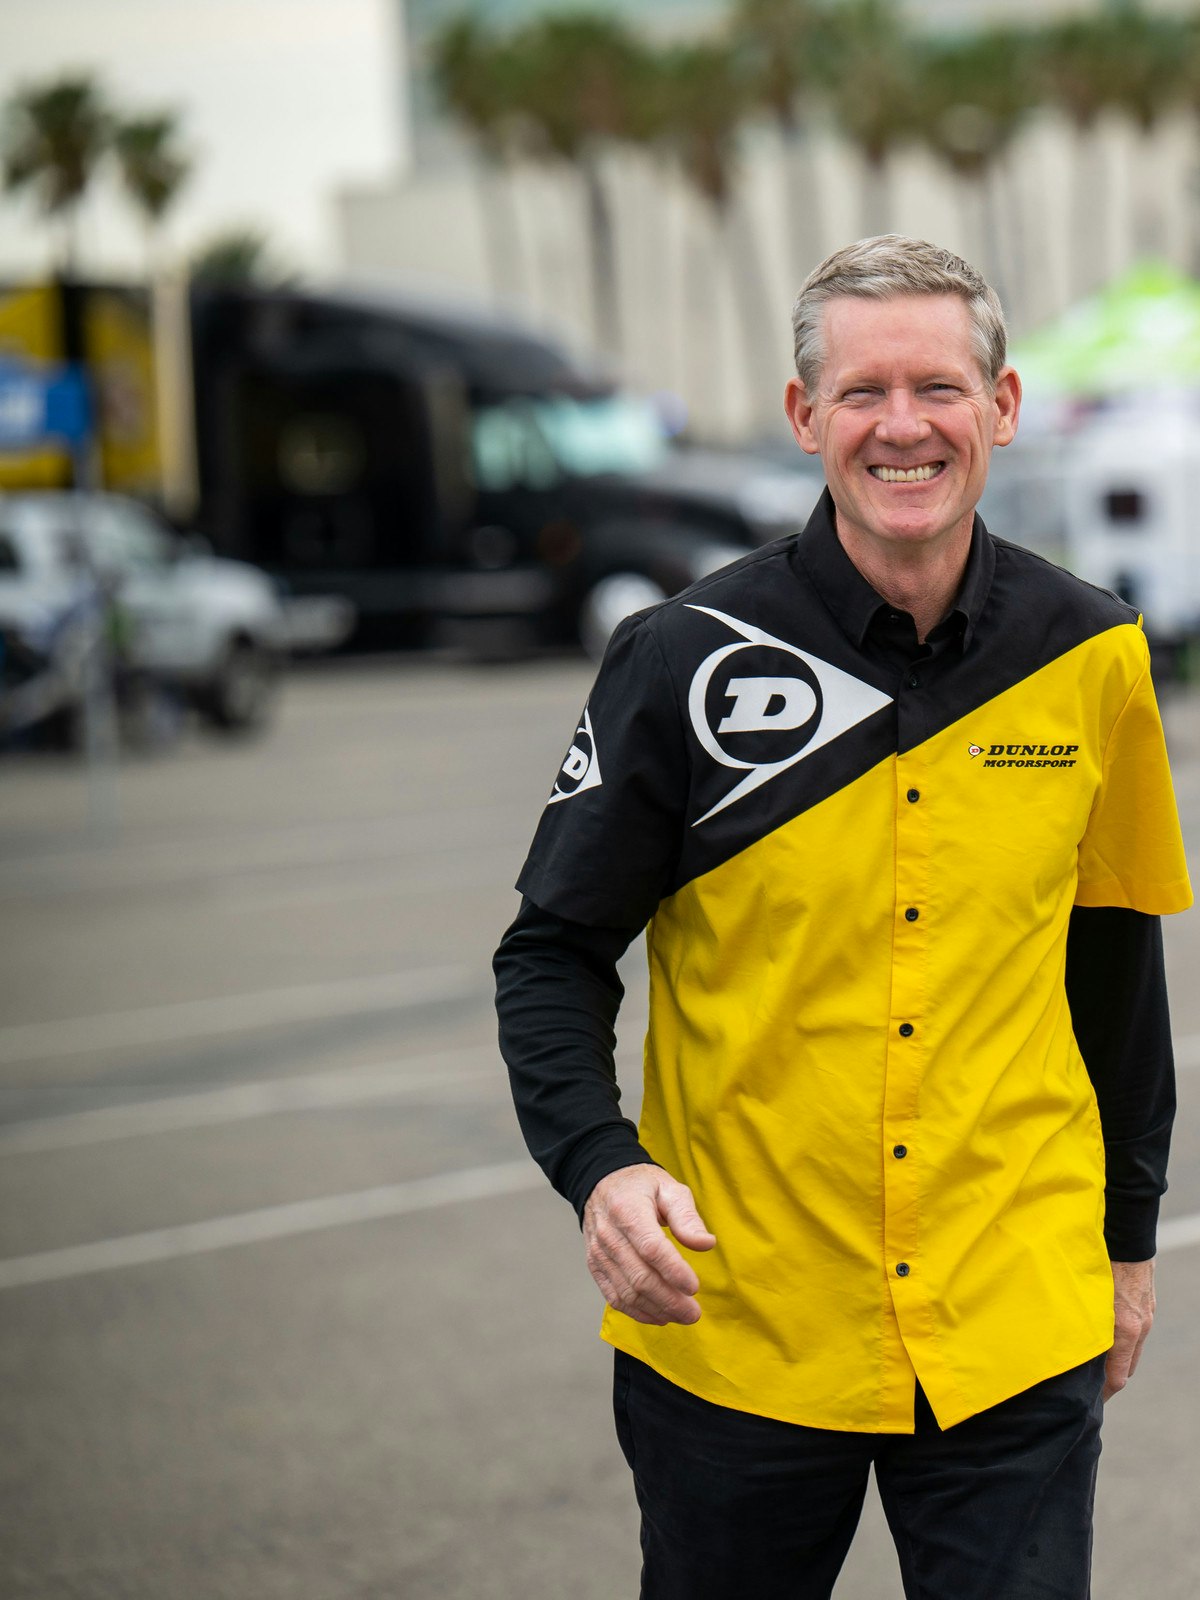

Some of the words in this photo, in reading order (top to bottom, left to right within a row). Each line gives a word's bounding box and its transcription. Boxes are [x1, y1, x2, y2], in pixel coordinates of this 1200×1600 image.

[717, 677, 817, 733] D
[562, 744, 589, 781] D
[987, 745, 1078, 755] DUNLOP
